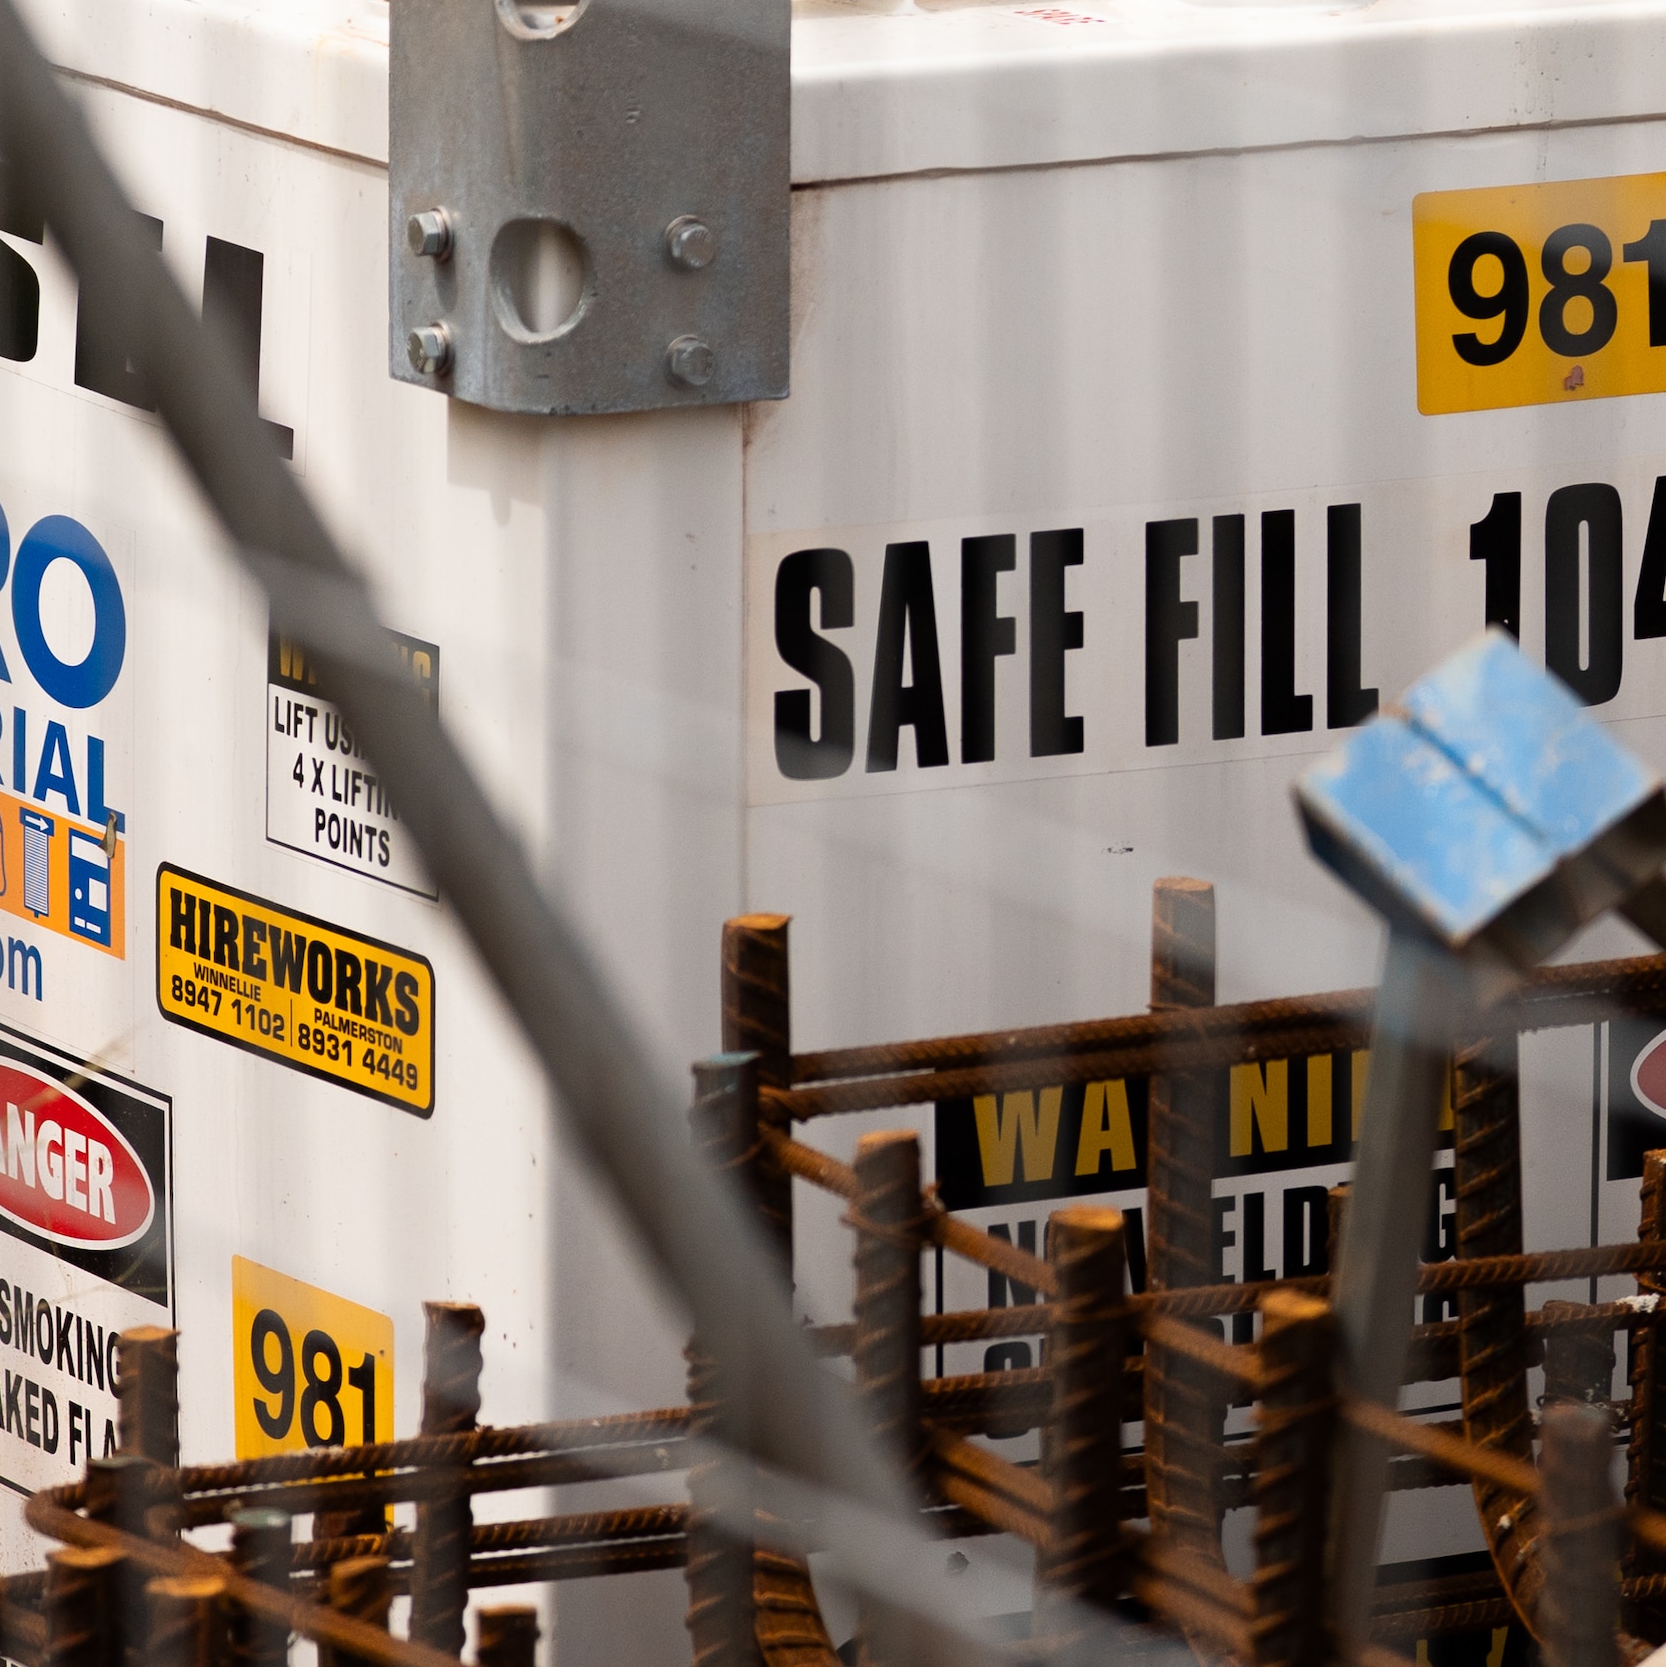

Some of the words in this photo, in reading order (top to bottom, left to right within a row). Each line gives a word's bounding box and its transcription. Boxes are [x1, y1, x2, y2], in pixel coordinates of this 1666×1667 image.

[774, 527, 1085, 782] SAFE
[1145, 502, 1379, 748] FILL
[275, 696, 318, 743] LIFT
[293, 753, 304, 788] 4
[311, 757, 324, 796] X
[332, 765, 398, 820] LIFTI
[315, 808, 390, 867] POINTS
[170, 887, 419, 1036] HIREWORKS
[193, 962, 261, 1002] WINNELLIE
[171, 975, 222, 1016] 8947
[231, 998, 285, 1042] 1102
[314, 1008, 403, 1054] PALMERSTON
[298, 1024, 352, 1067] 8931
[362, 1048, 418, 1090] 4449
[973, 1048, 1455, 1187] WANI
[251, 1309, 375, 1478] 981
[69, 1400, 119, 1466] FLA
